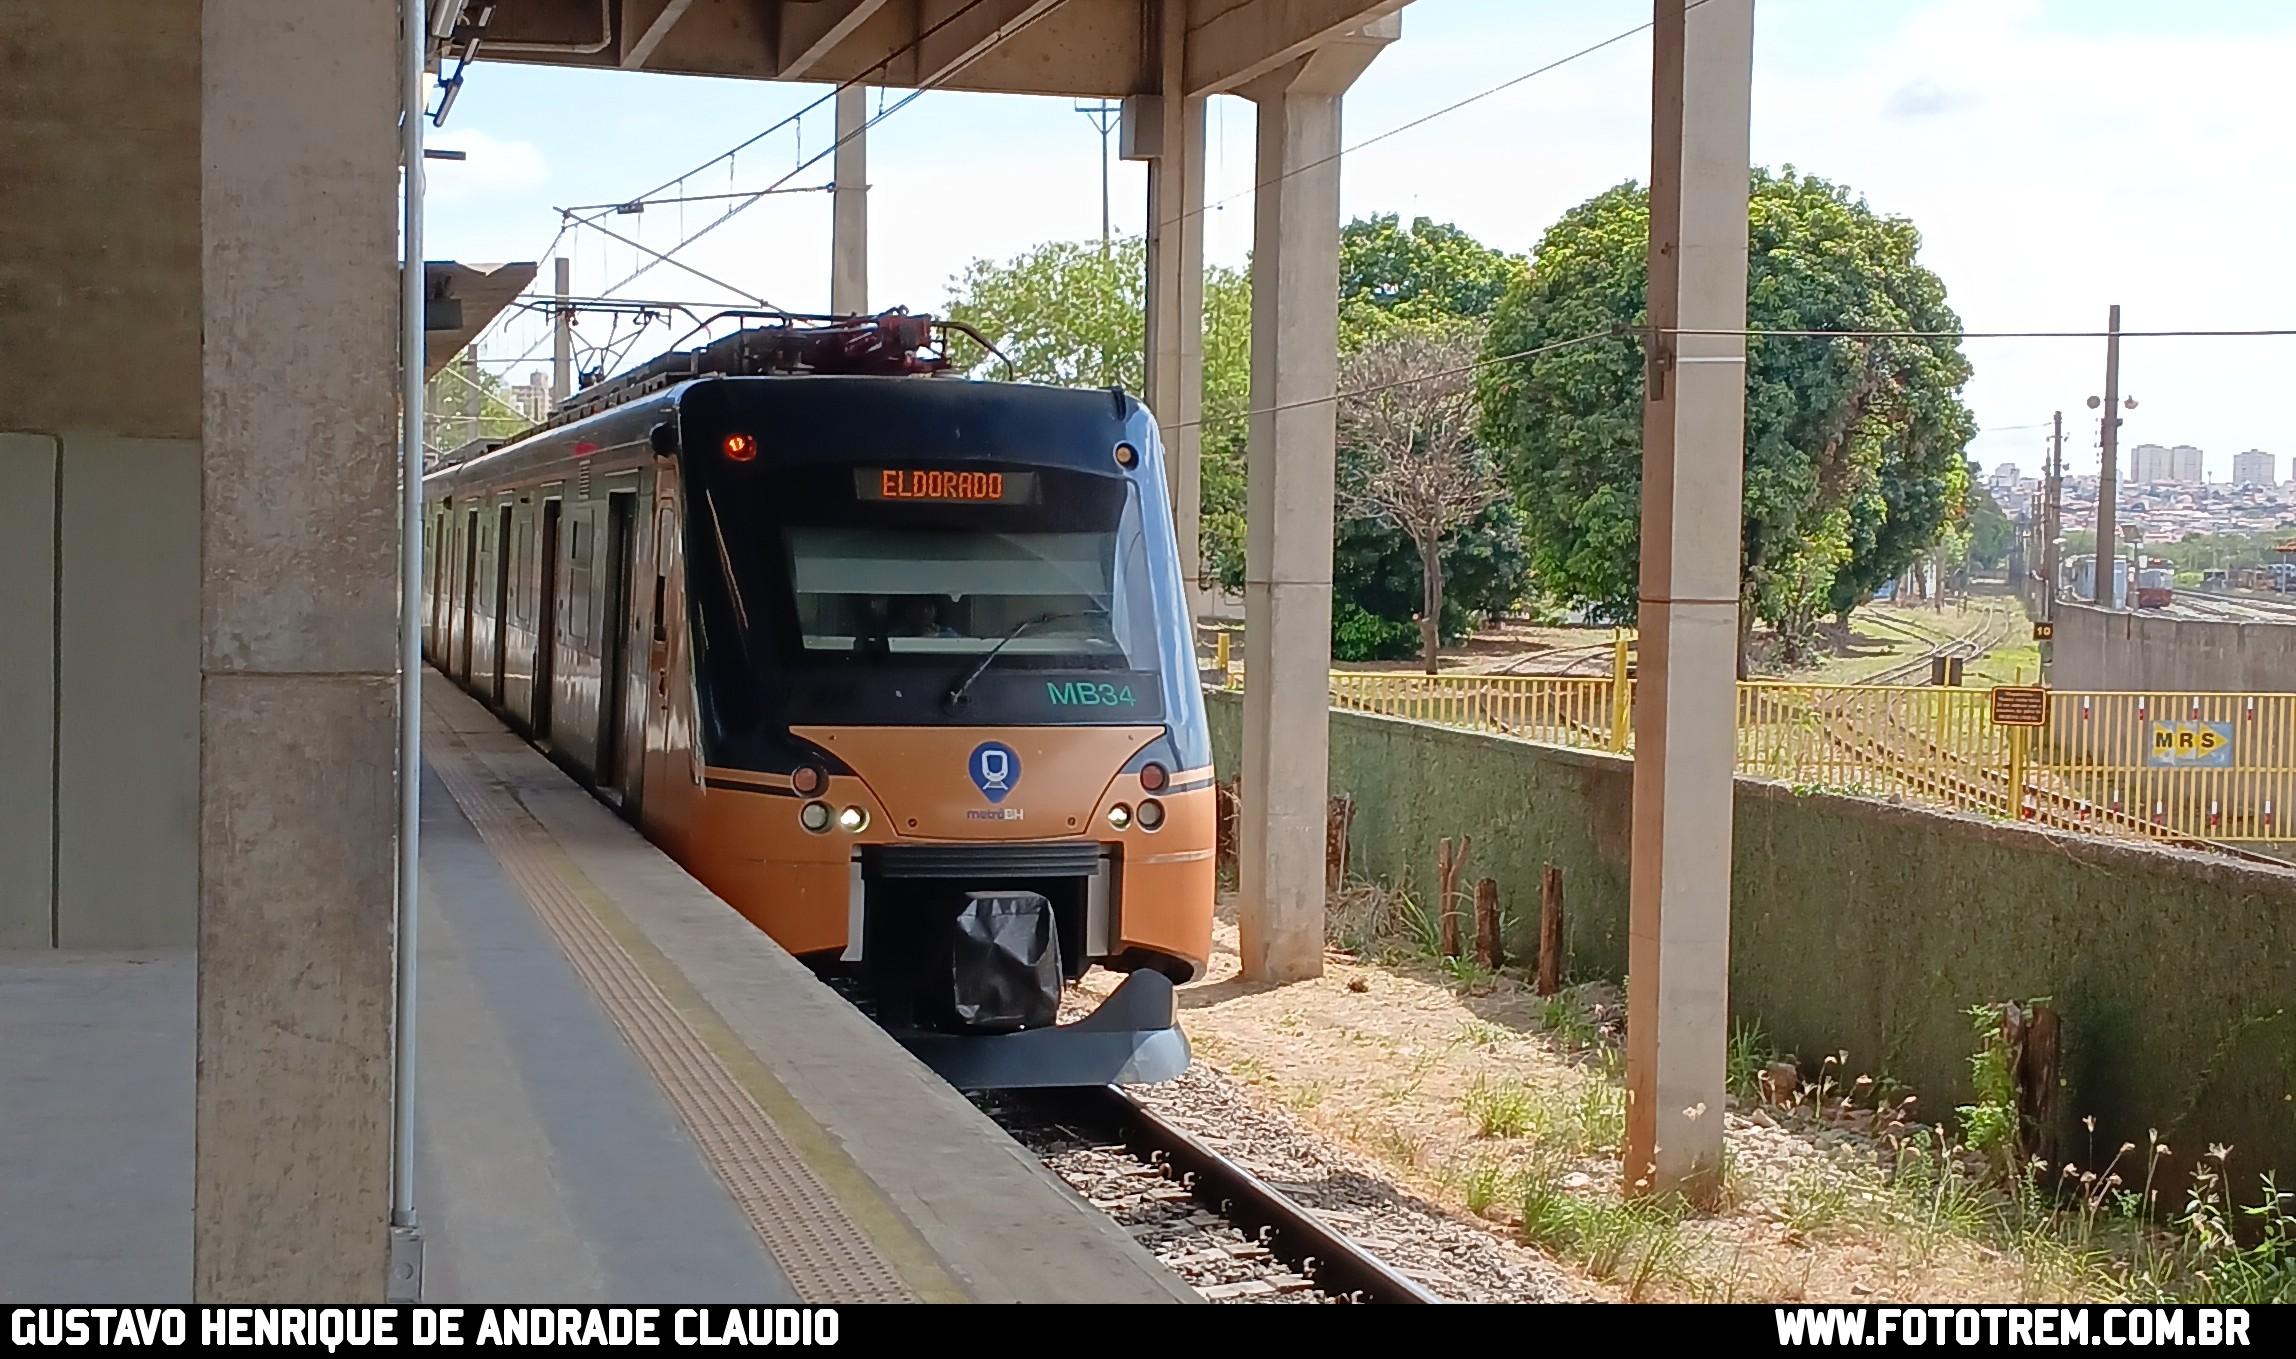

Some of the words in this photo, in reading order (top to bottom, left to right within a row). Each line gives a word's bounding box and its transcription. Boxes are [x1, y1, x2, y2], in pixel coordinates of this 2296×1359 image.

[883, 469, 1001, 498] ELDORADO
[2037, 626, 2051, 636] 10
[1047, 682, 1137, 707] MB34
